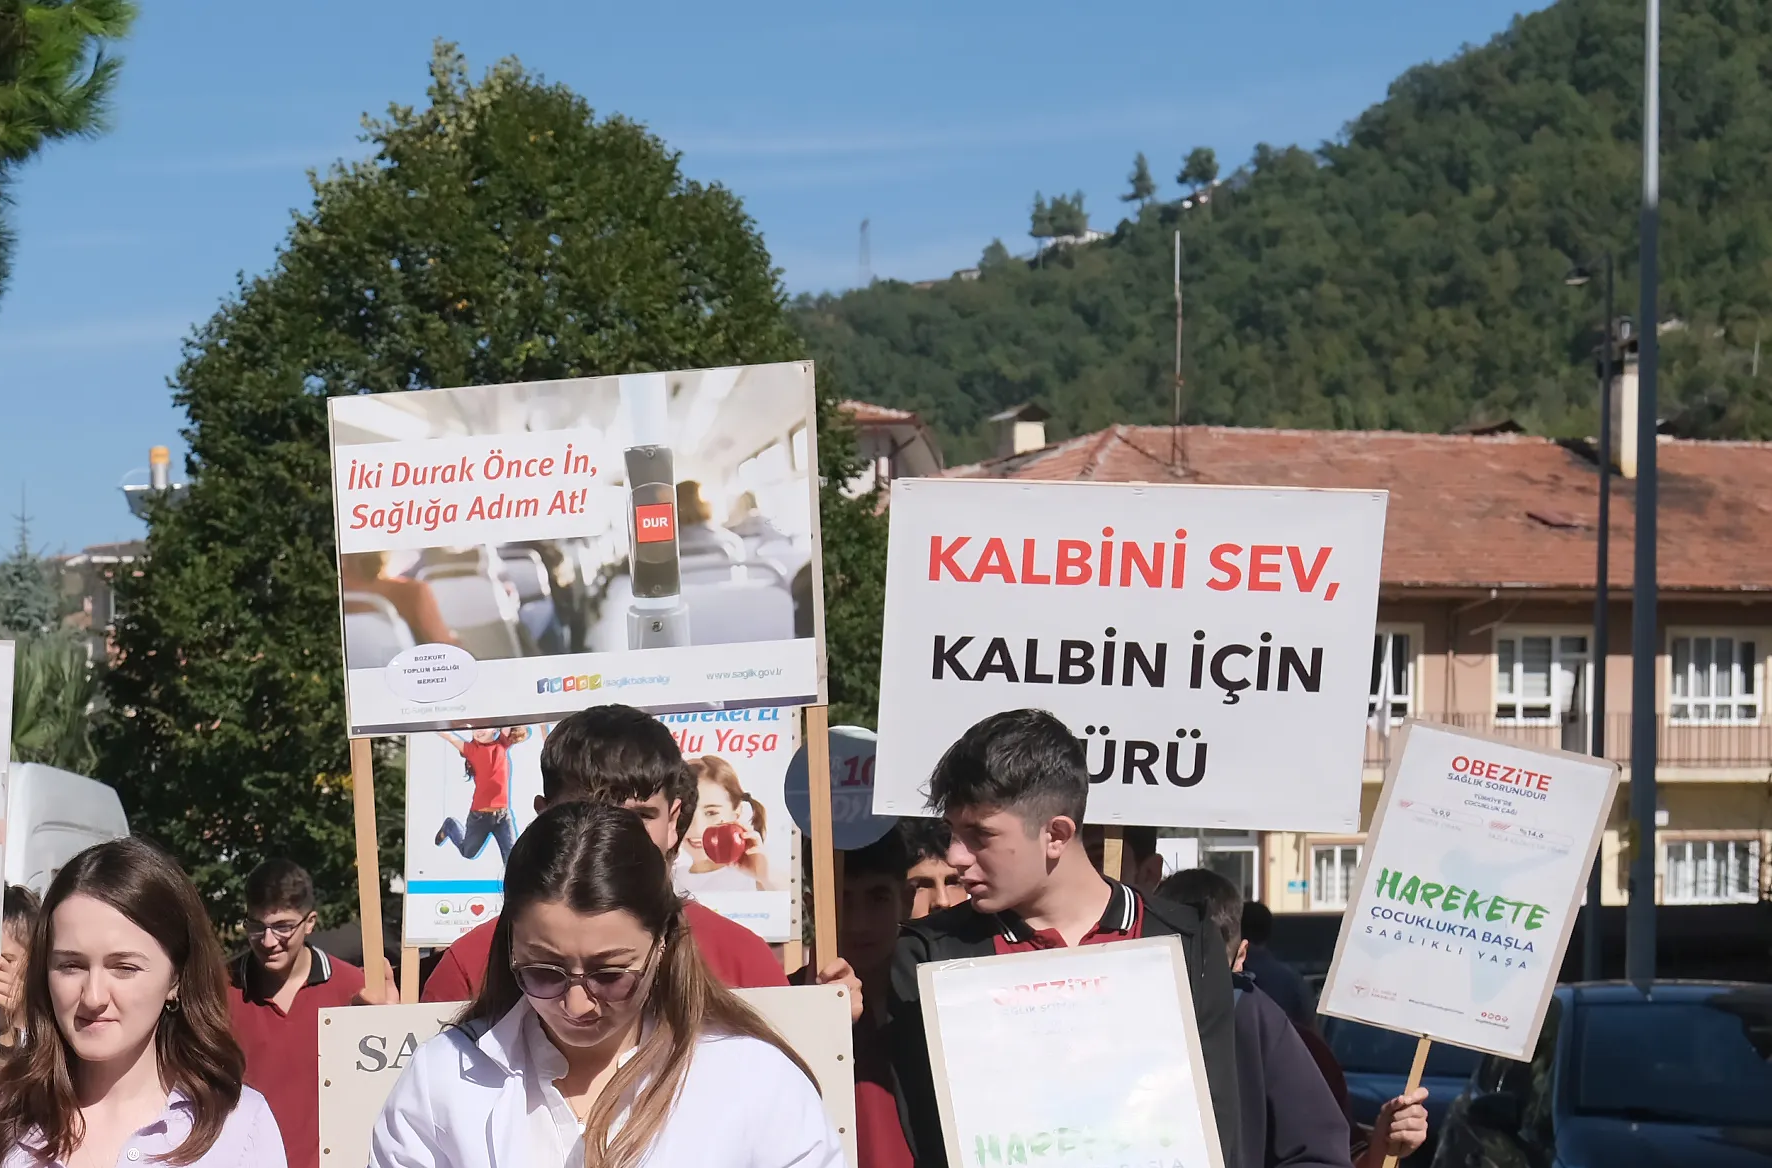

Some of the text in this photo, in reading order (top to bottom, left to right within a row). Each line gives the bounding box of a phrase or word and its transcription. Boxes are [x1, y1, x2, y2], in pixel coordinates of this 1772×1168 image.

[348, 443, 597, 490] İki Durak Önce İn,
[349, 488, 587, 533] Sağlığa Adım At!
[642, 517, 668, 529] DUR
[928, 526, 1340, 602] KALBİNİ SEV,
[931, 626, 1324, 705] KALBİN İÇİN
[715, 728, 779, 758] Yaşa
[1078, 725, 1208, 788] ÜRÜ
[1447, 772, 1547, 802] SAĞLIK SORUNUDUR
[1376, 867, 1550, 931] HAREKETE
[1365, 925, 1527, 969] SAĞLIKLI YAŞA
[1370, 906, 1534, 953] ÇOCUKLUKTA BAŞLA
